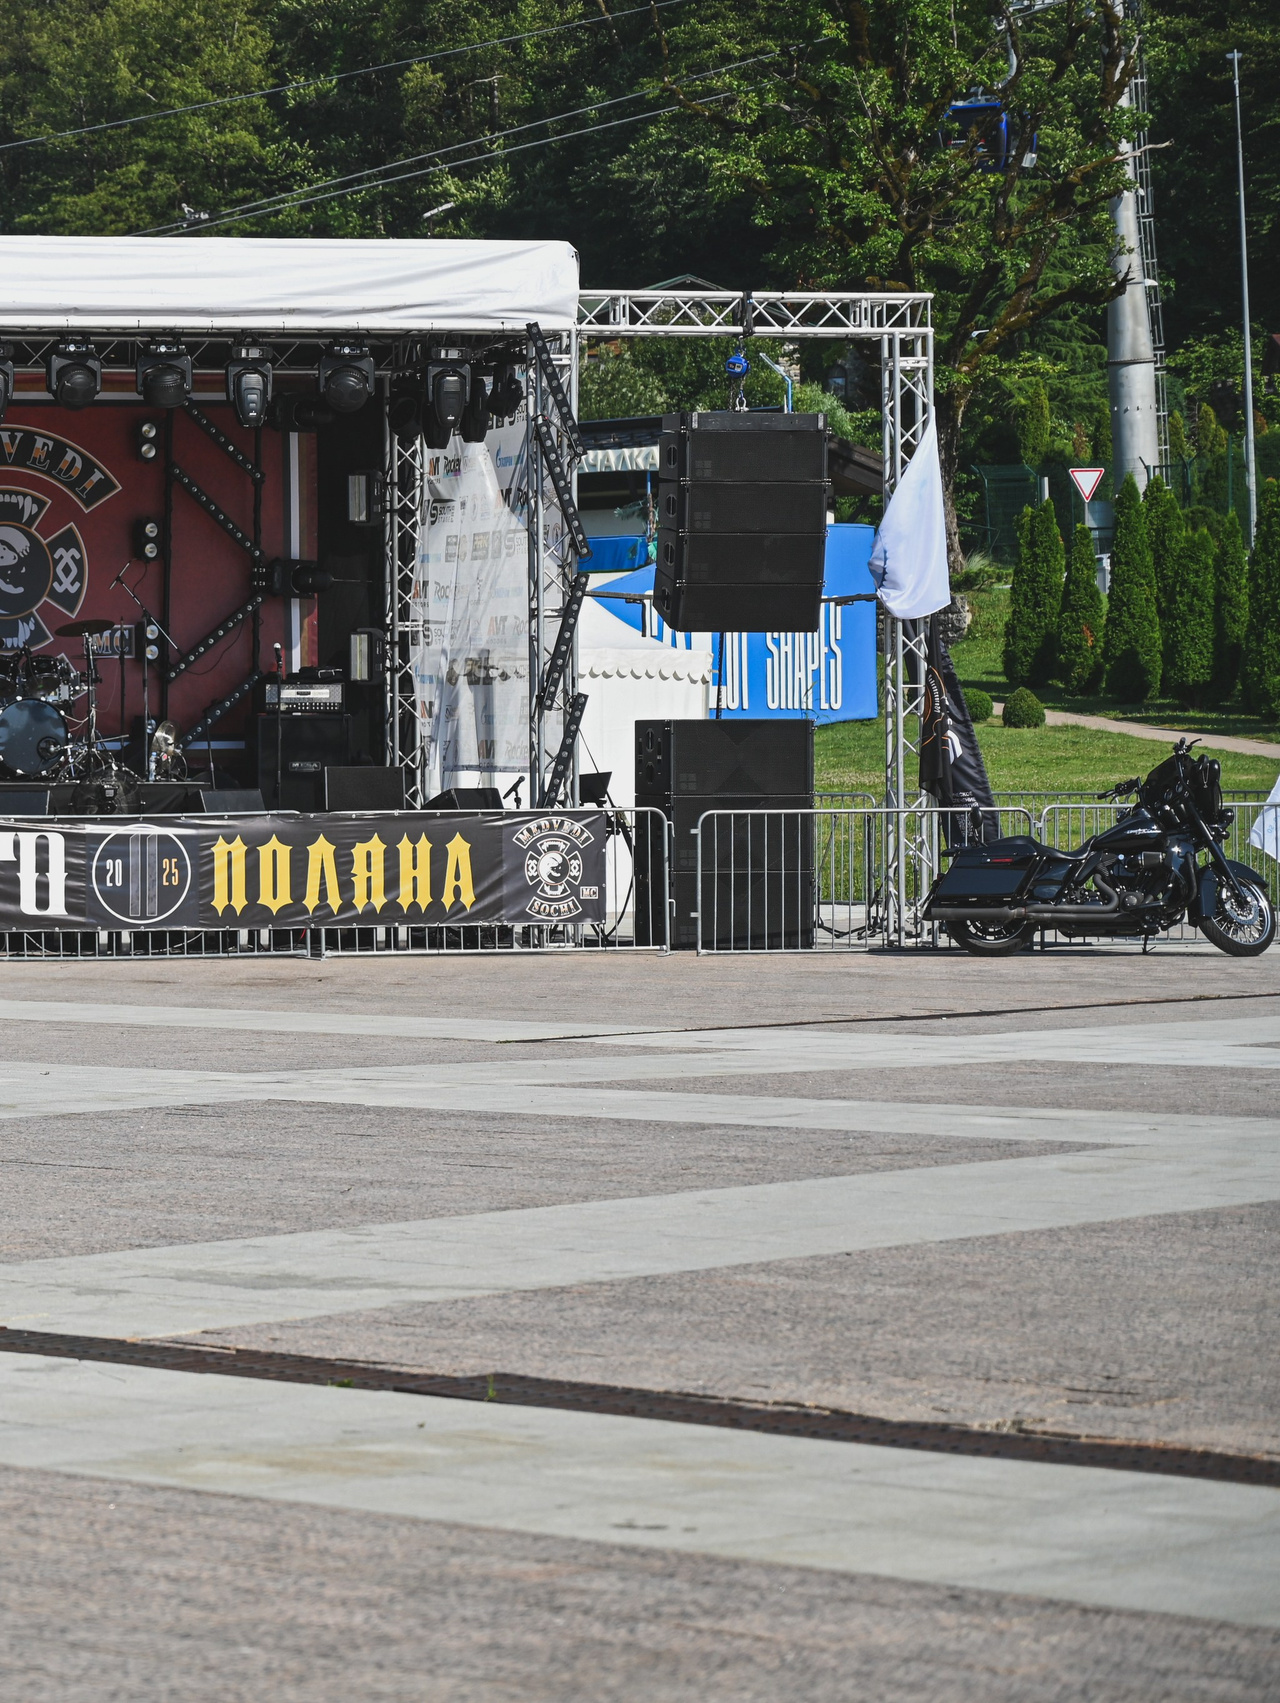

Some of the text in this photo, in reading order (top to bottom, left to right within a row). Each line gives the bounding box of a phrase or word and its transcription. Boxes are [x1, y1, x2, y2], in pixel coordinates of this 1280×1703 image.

[90, 629, 129, 654] MC
[518, 818, 589, 845] MEDVEDI
[106, 858, 123, 887] 20
[162, 858, 179, 886] 25
[210, 831, 477, 917] ПОЛЯНА
[581, 887, 598, 899] MC
[531, 900, 577, 918] SOCHI
